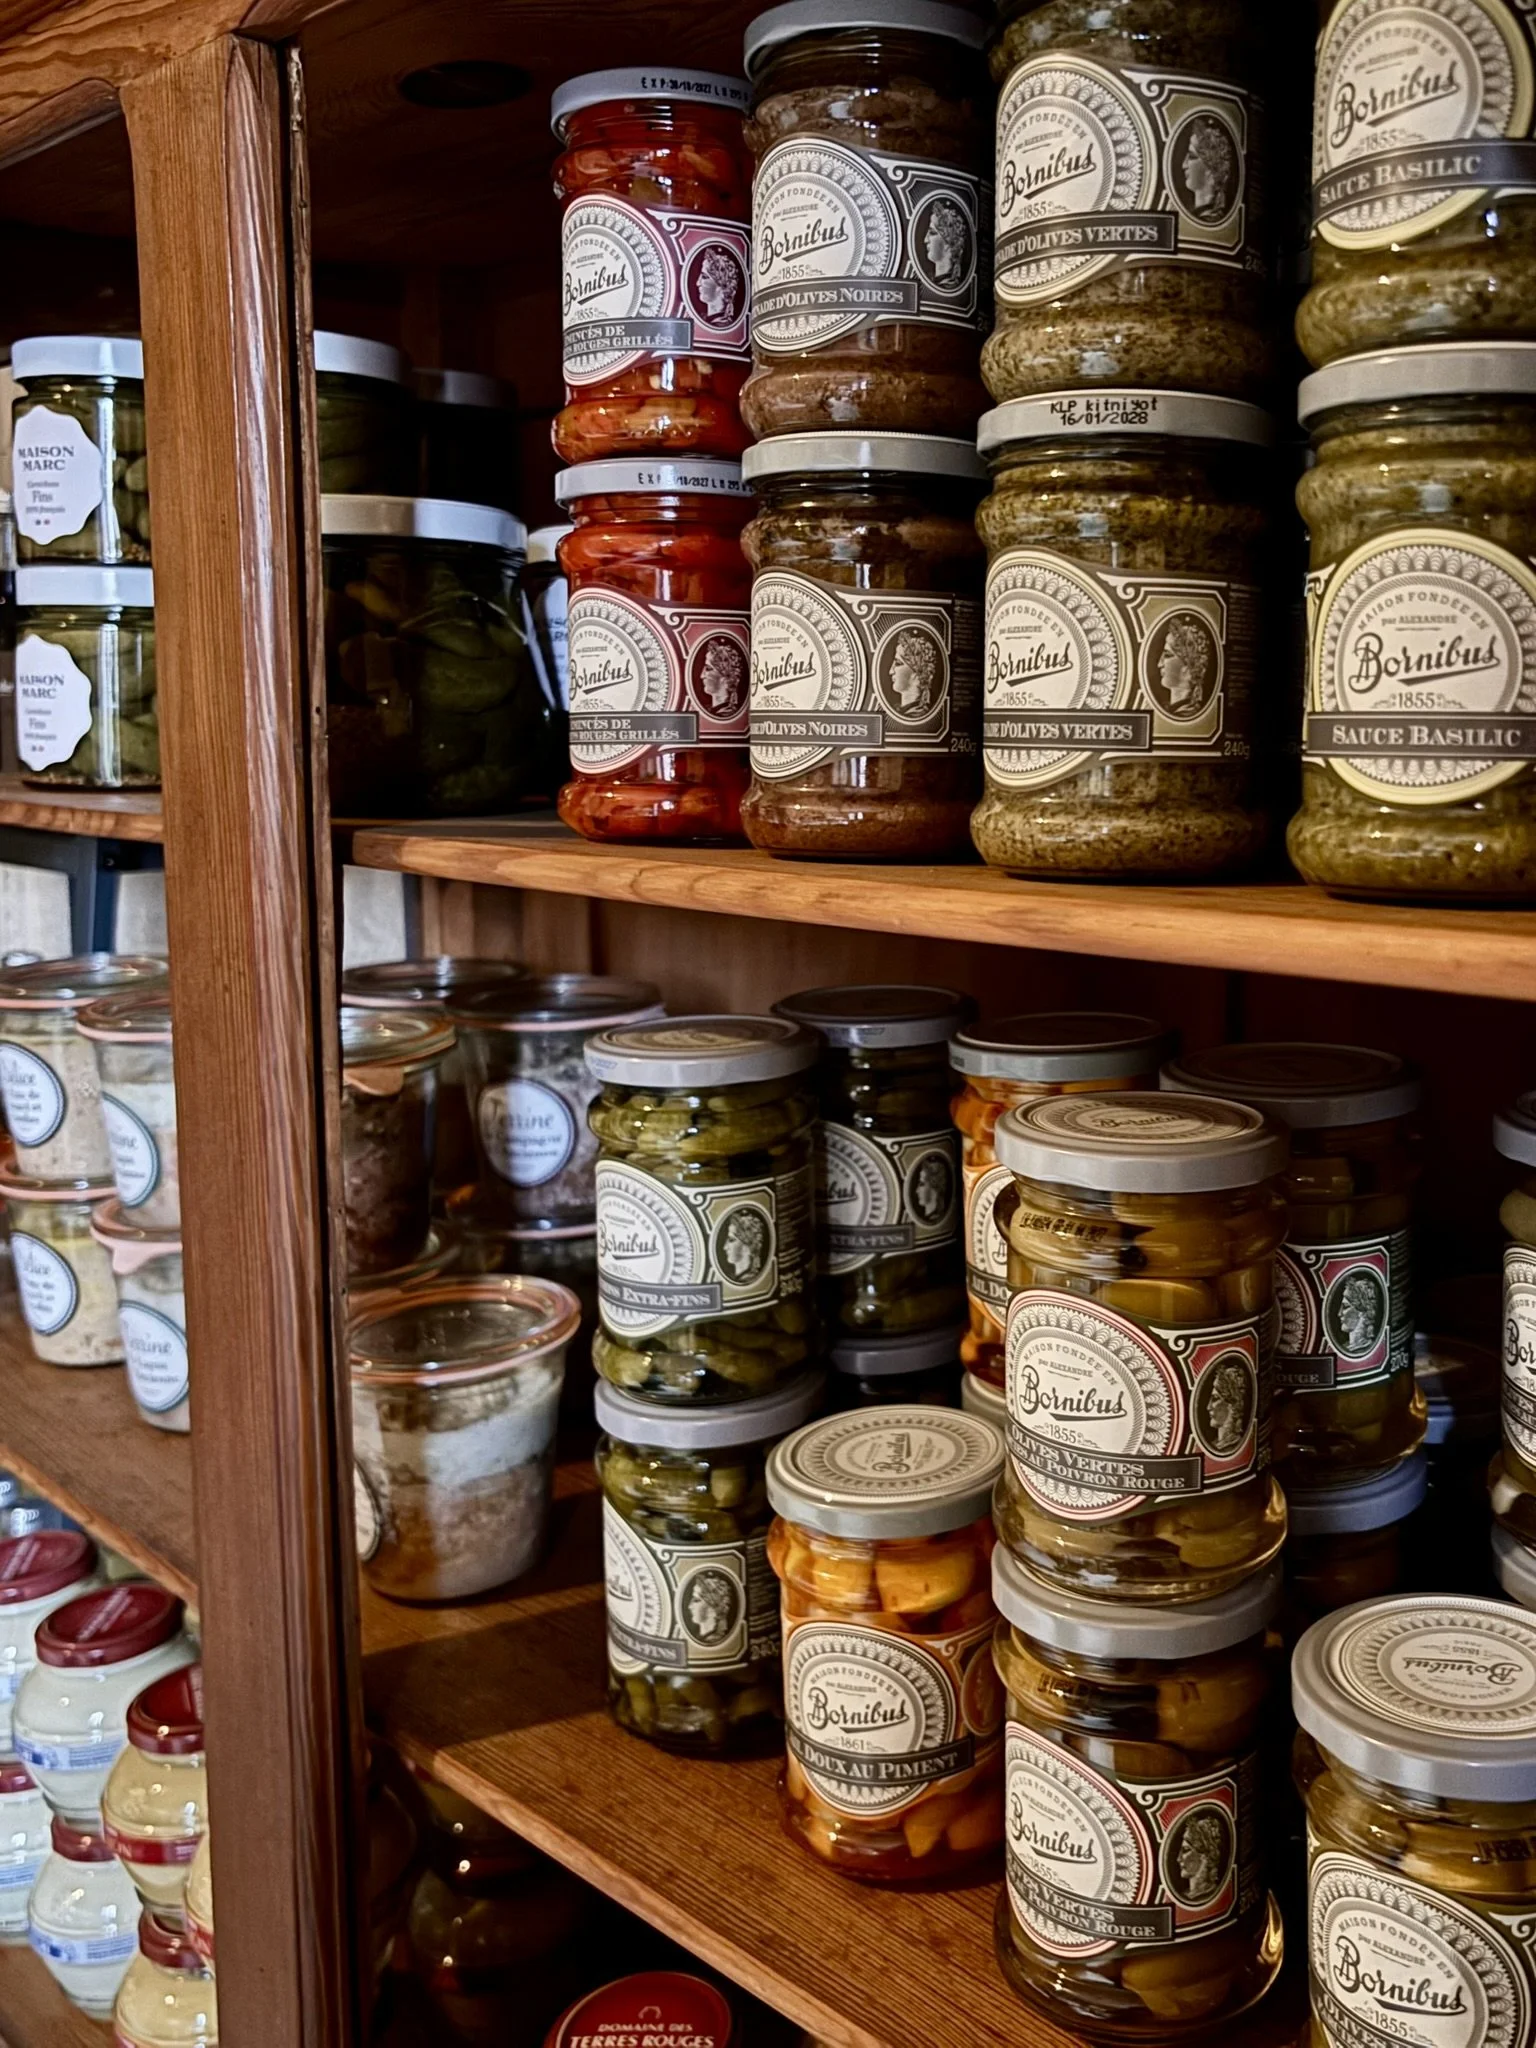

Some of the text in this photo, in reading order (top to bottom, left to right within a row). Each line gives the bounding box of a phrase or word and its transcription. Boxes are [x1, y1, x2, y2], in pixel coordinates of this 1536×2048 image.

[1330, 60, 1460, 150] Bornibus
[1364, 130, 1398, 152] 1855
[1000, 142, 1097, 218] Bornibus
[1320, 155, 1481, 206] SAUCE BASILIC
[1022, 200, 1048, 220] 1855
[758, 216, 849, 276] Bornibus
[1016, 228, 1082, 254] D'OLIVES
[1084, 226, 1158, 242] VERTES
[782, 264, 805, 280] 1855
[564, 264, 630, 316] Bornibus
[838, 287, 904, 304] NOIRES
[573, 333, 674, 351] ROUGES GRILLÉS
[605, 326, 625, 338] DE
[1050, 395, 1158, 414] KLP kitniyot
[1060, 412, 1148, 426] 16/01/2028
[18, 446, 74, 458] MAISON
[22, 459, 66, 472] MARC
[1358, 592, 1490, 631] MAISON FONDÉE EN
[1381, 616, 1397, 627] par
[751, 651, 817, 698] Bornibus
[987, 640, 1074, 694] Bornibus
[1348, 632, 1500, 694] Bornibus
[569, 658, 634, 702] Bornibus
[22, 688, 57, 700] MARC
[1006, 692, 1027, 706] 1855
[1398, 692, 1436, 709] 1855
[580, 730, 618, 740] ROUGES
[619, 728, 680, 740] GRILLÉS
[611, 719, 632, 730] DE
[808, 721, 868, 736] NOIRES
[1000, 720, 1060, 739] D'OLIVES
[1060, 724, 1133, 741] VERTES
[1332, 724, 1522, 748] SAUCE BASILIC
[599, 1218, 660, 1260] Bornibus
[622, 1286, 712, 1307] EXTRA-FINS
[1056, 1344, 1102, 1370] FONDÉE
[1102, 1370, 1118, 1386] EN
[1019, 1364, 1128, 1422] Bornibus
[1049, 1424, 1077, 1444] 1855
[1011, 1425, 1060, 1463] OLIVES
[1062, 1450, 1146, 1477] VERTES
[1028, 1455, 1185, 1490] AU POIVRON ROUGE
[1402, 1656, 1523, 1686] Bornibus
[807, 1686, 910, 1734] Bornibus
[840, 1736, 865, 1750] 1861
[804, 1744, 848, 1774] DOUX
[850, 1764, 874, 1778] AU
[878, 1751, 958, 1780] PIMENT
[1010, 1792, 1098, 1864] Bornibus
[1030, 1856, 1054, 1880] 1855
[1028, 1892, 1156, 1937] POIVRON ROUGE
[1040, 1884, 1116, 1925] VERTES
[1338, 1916, 1455, 1980] MAISON FONDÉE EN
[1333, 1935, 1468, 2016] Bornibus
[597, 2022, 693, 2033] DOMAINE DES
[1375, 2010, 1408, 2038] 1855
[570, 2034, 714, 2048] TERRES ROUGES
